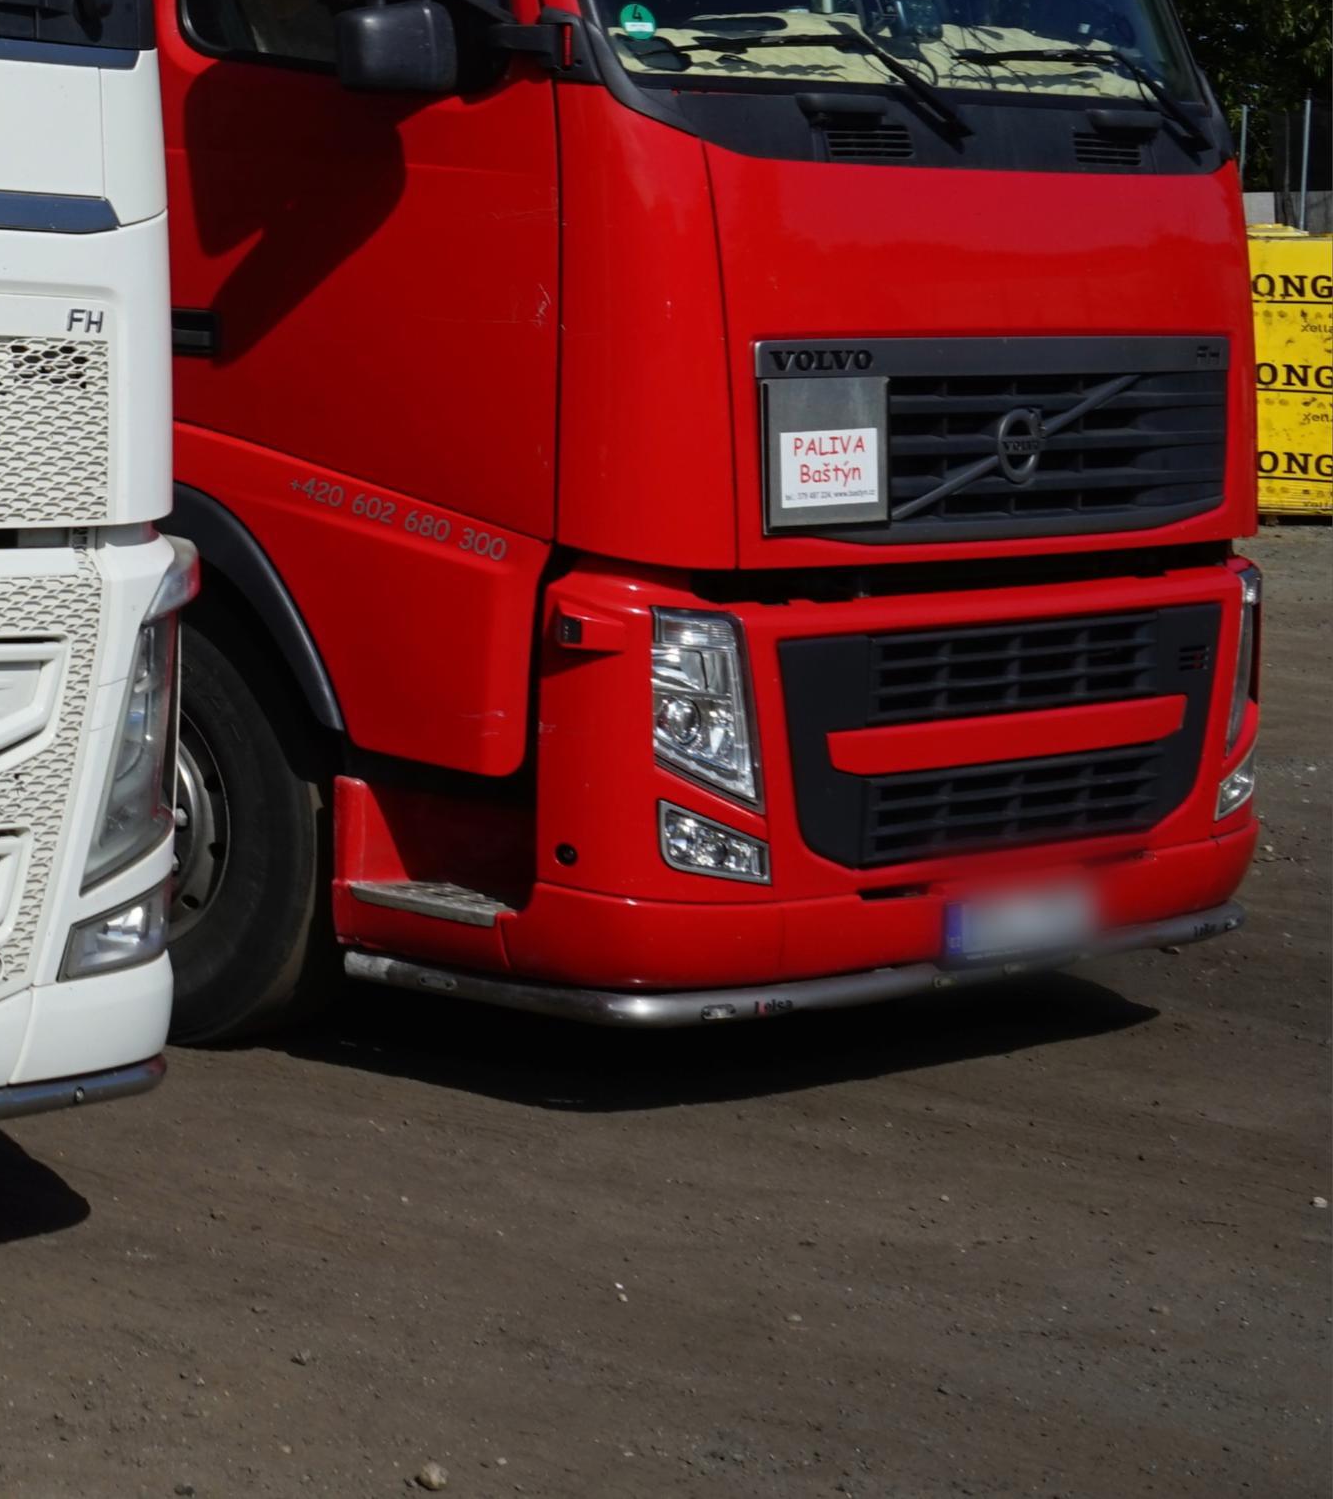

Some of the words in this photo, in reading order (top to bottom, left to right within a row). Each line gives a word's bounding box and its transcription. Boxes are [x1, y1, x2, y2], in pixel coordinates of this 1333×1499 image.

[632, 4, 643, 21] 4
[66, 308, 104, 333] FH
[768, 350, 874, 371] VOLVO
[793, 435, 866, 457] PALIVA
[799, 461, 862, 487] Baštýn
[290, 477, 344, 508] +420
[352, 493, 397, 524] 602
[404, 510, 451, 541] 680
[459, 527, 507, 561] 300
